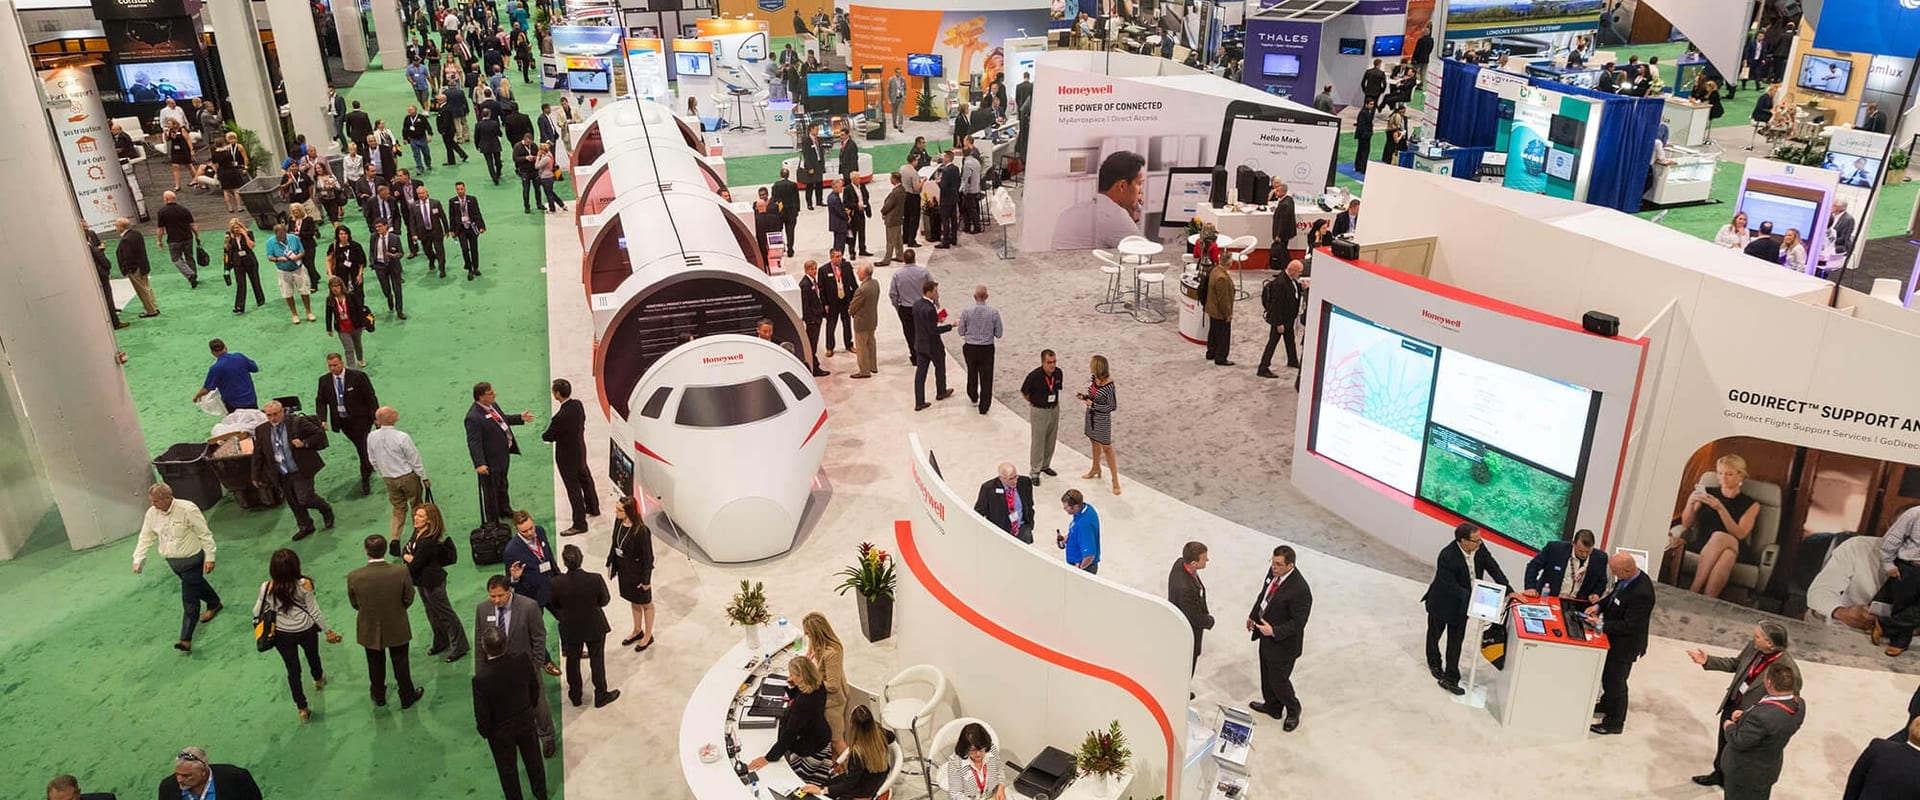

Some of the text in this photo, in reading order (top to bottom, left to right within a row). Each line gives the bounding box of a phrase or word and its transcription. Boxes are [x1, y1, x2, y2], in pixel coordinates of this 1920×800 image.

[1258, 33, 1309, 43] THALES
[1869, 65, 1904, 78] omlux
[1058, 84, 1113, 96] Honeywell
[1058, 102, 1163, 112] THE POWER OF CONNECTED
[1058, 116, 1105, 125] MyAerospace
[1260, 133, 1303, 144] Hello Mark.
[1422, 309, 1461, 328] Honeywell
[702, 353, 744, 364] Honeywell
[1821, 405, 1900, 429] SUPPORT
[1723, 409, 1762, 423] GoDirect
[1764, 417, 1791, 429] Flight
[1792, 422, 1831, 435] Support
[1832, 429, 1873, 443] Services
[1879, 437, 1920, 450] GoDirec
